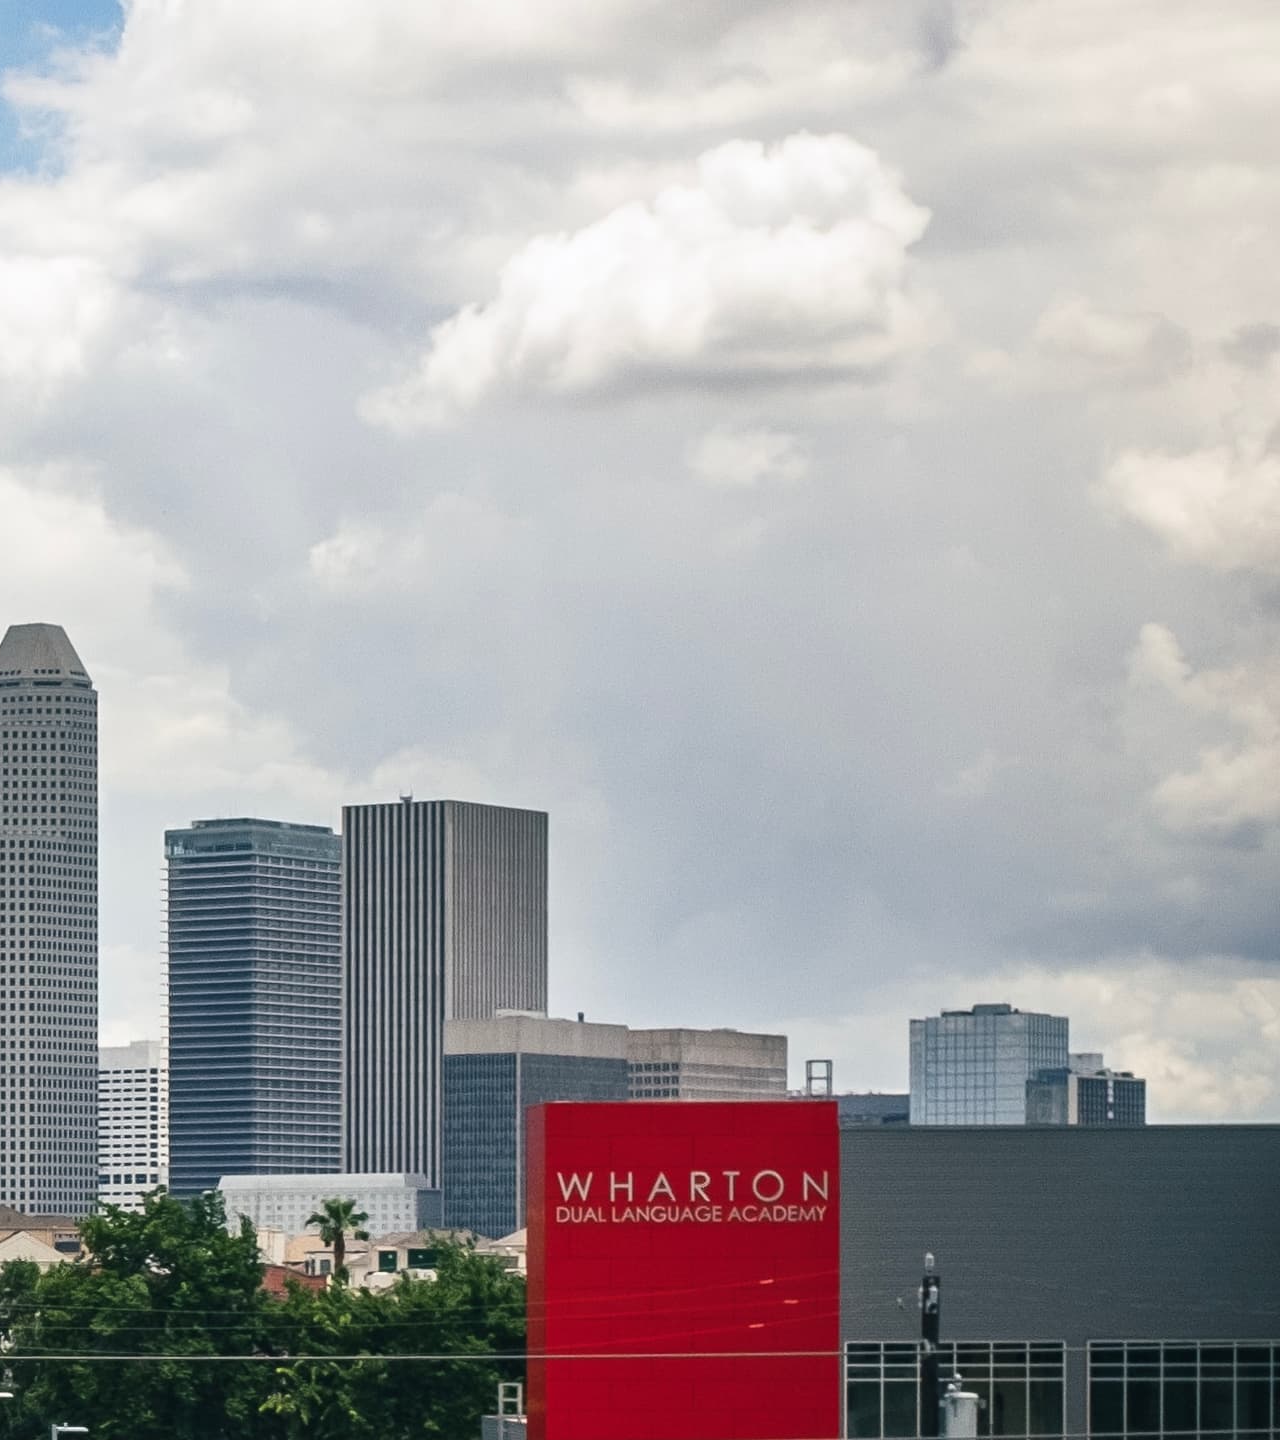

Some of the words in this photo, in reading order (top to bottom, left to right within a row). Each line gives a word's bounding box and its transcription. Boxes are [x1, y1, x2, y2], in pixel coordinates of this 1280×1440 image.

[557, 1169, 828, 1202] WHARTON
[556, 1206, 607, 1223] DUAL
[611, 1205, 722, 1222] LANGUAGE
[727, 1205, 826, 1222] ACADEMY
